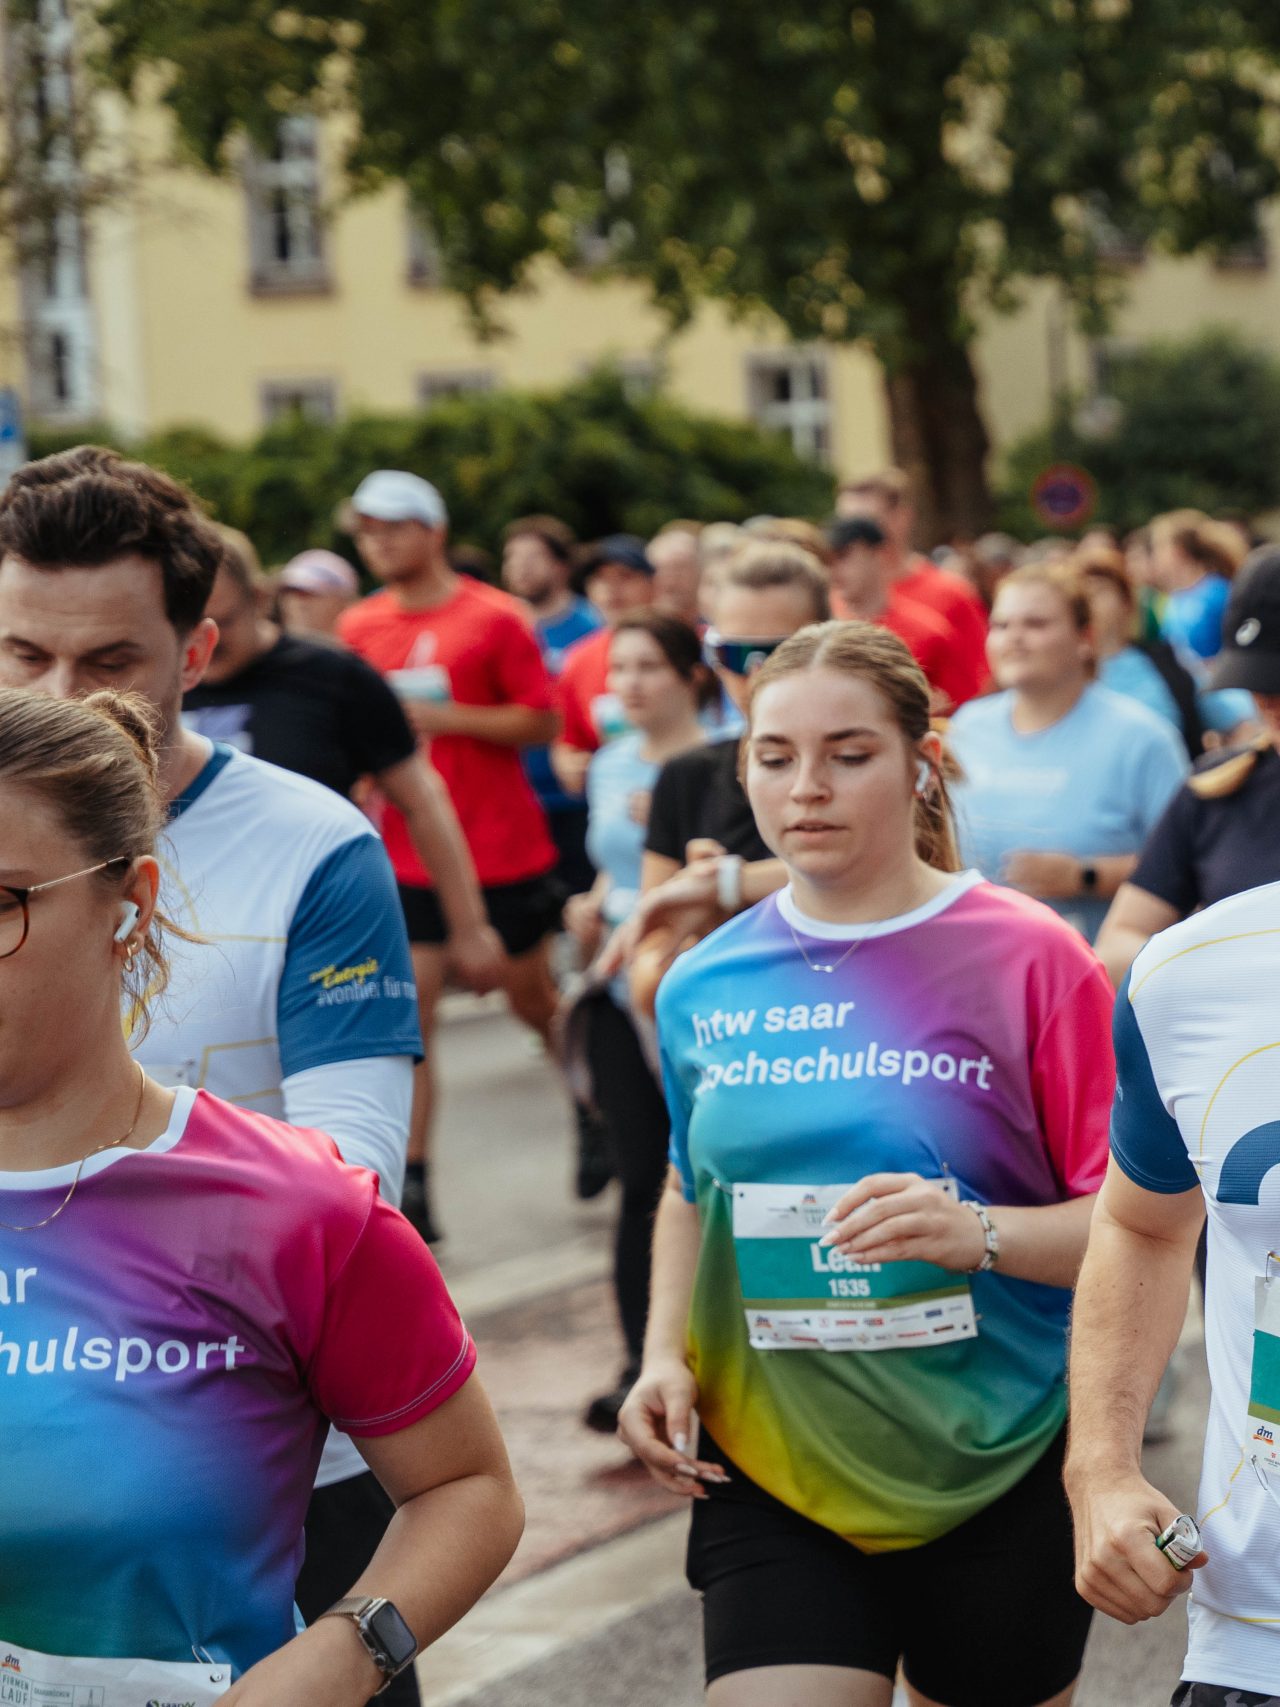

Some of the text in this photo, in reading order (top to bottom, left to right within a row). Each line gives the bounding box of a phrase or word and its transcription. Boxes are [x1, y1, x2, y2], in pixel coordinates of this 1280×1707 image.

[692, 1001, 855, 1049] htw saar
[694, 1041, 994, 1092] ochschulsport
[810, 1242, 881, 1272] Lea
[828, 1278, 871, 1297] 1535
[1256, 1425, 1274, 1439] dm
[5, 1653, 20, 1666] dm
[2, 1673, 29, 1691] FIRMEN
[1, 1686, 28, 1705] LAUF
